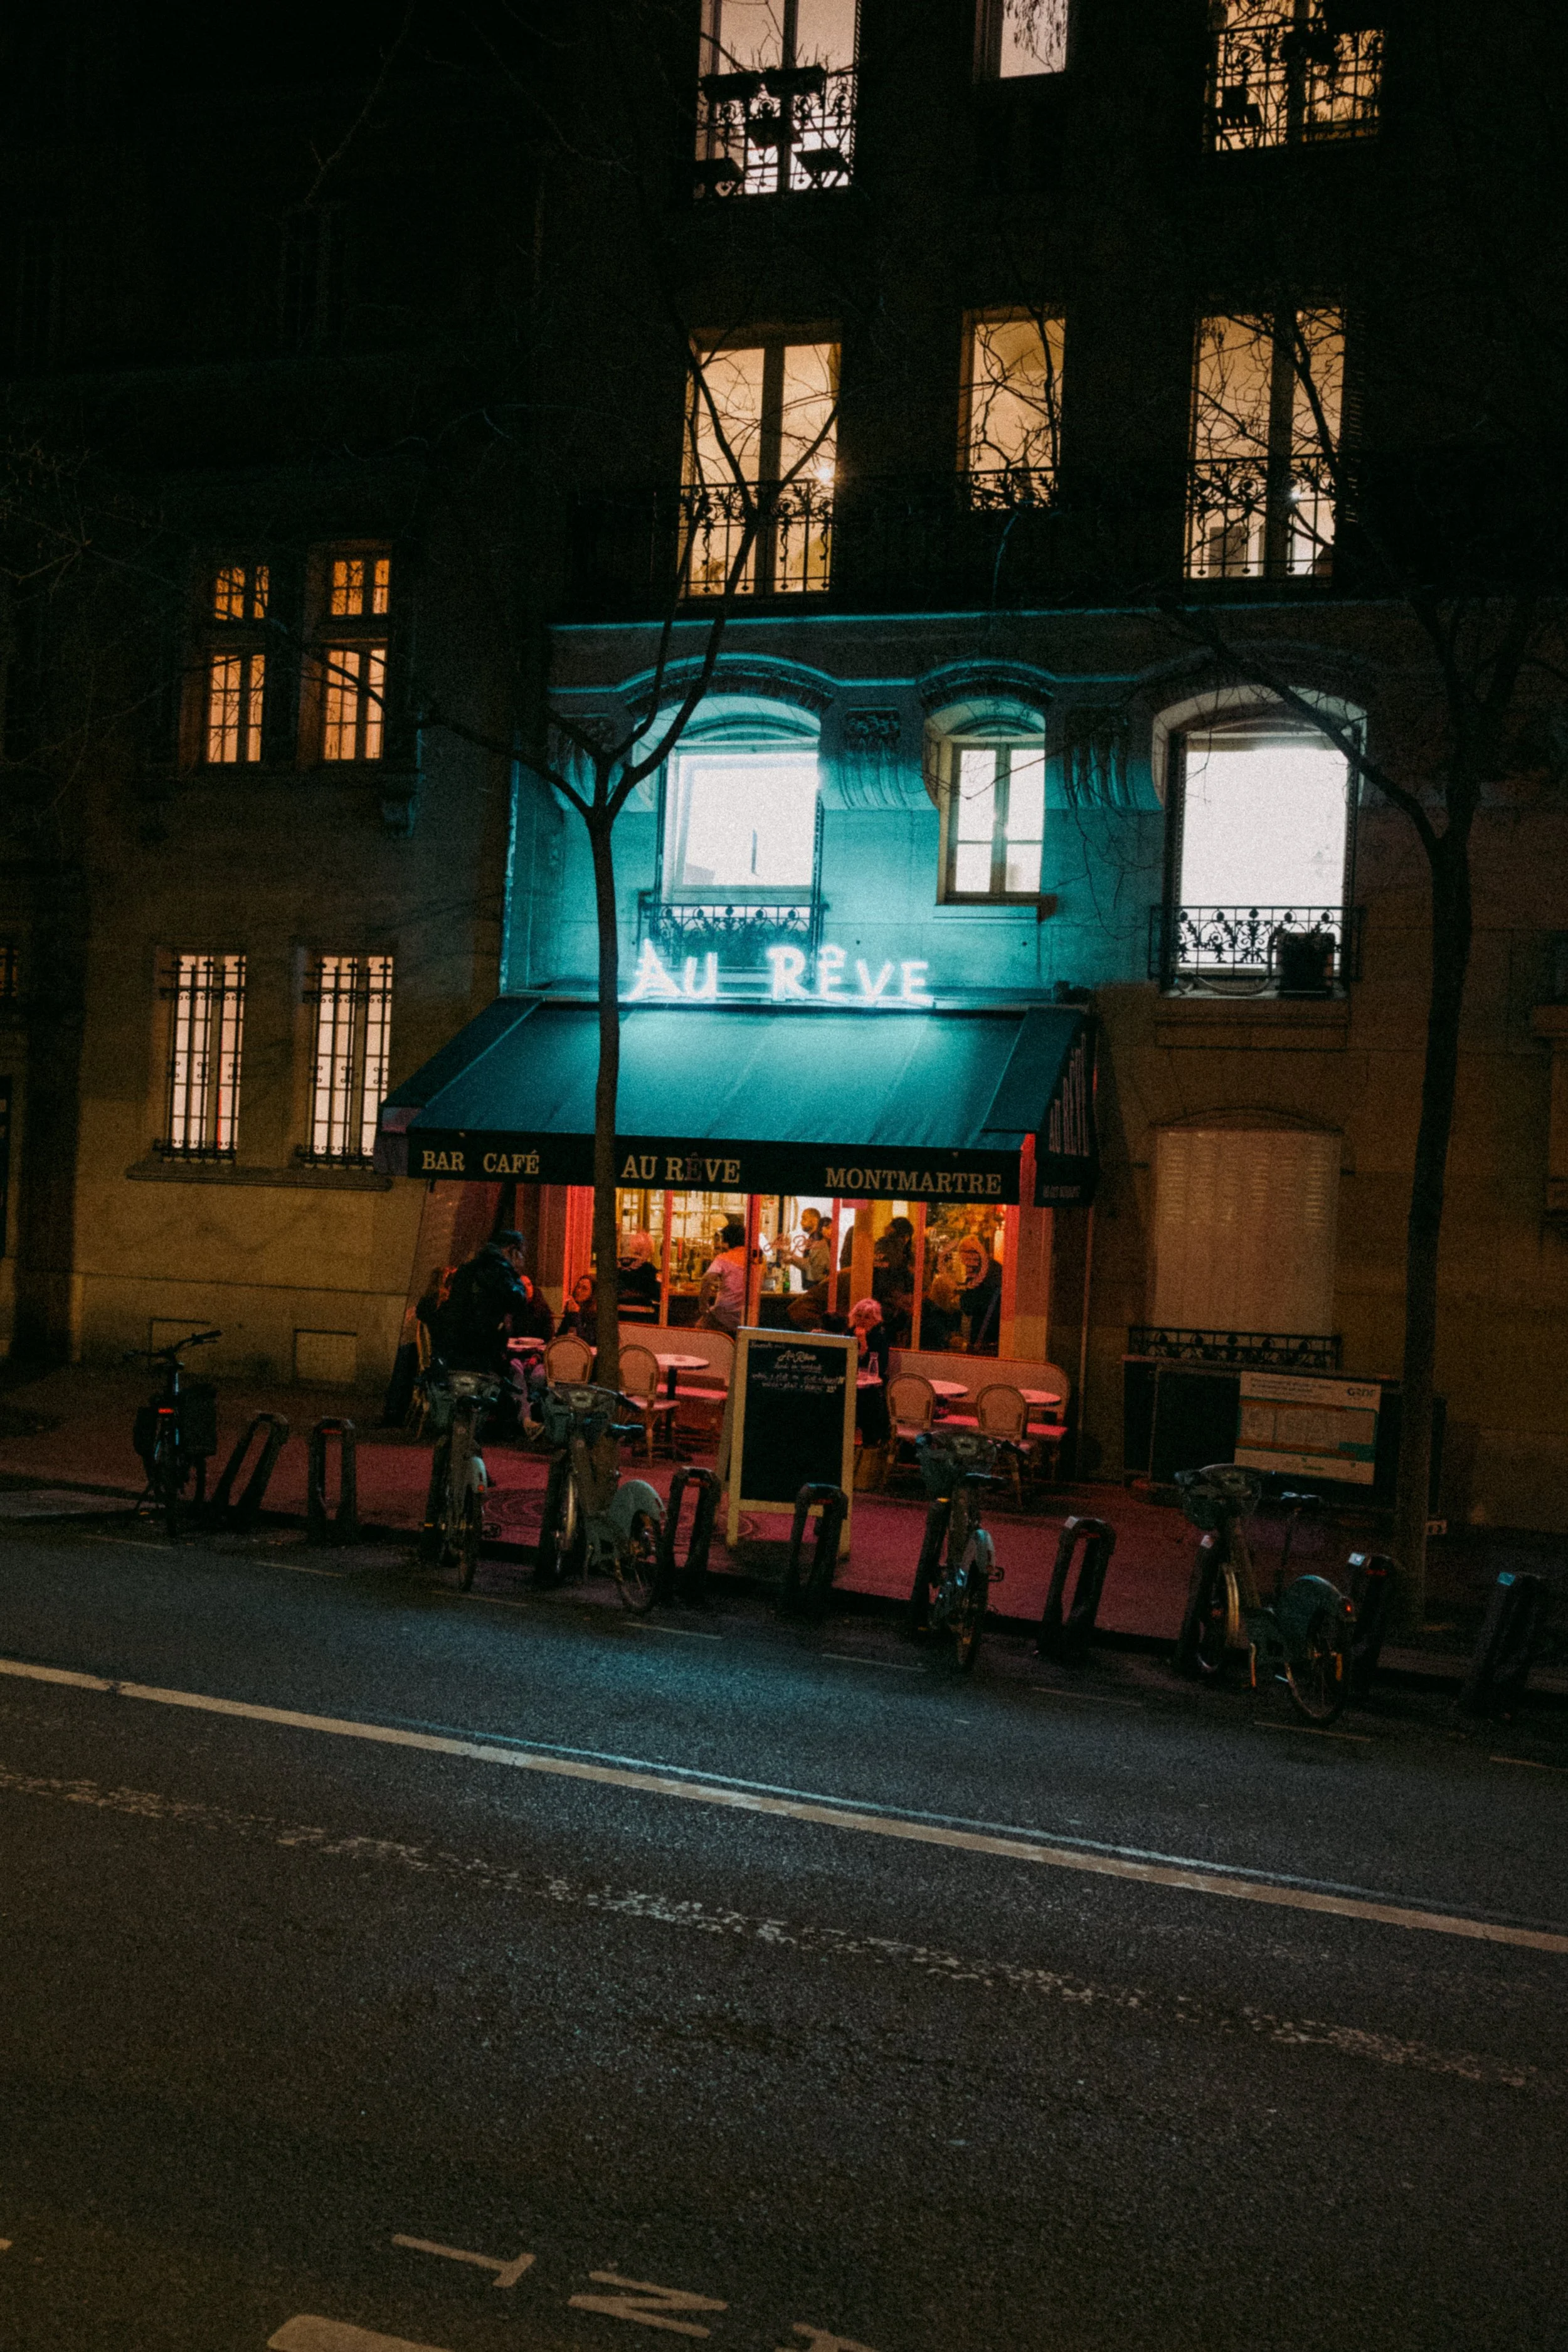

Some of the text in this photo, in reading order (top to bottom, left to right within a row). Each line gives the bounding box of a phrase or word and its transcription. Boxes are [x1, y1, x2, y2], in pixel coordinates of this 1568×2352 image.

[767, 945, 934, 1004] RÊVE
[422, 1150, 540, 1175] BAR CAFÉ
[620, 1152, 741, 1184] AU RÊVE
[825, 1167, 1002, 1195] MONTMARTRE
